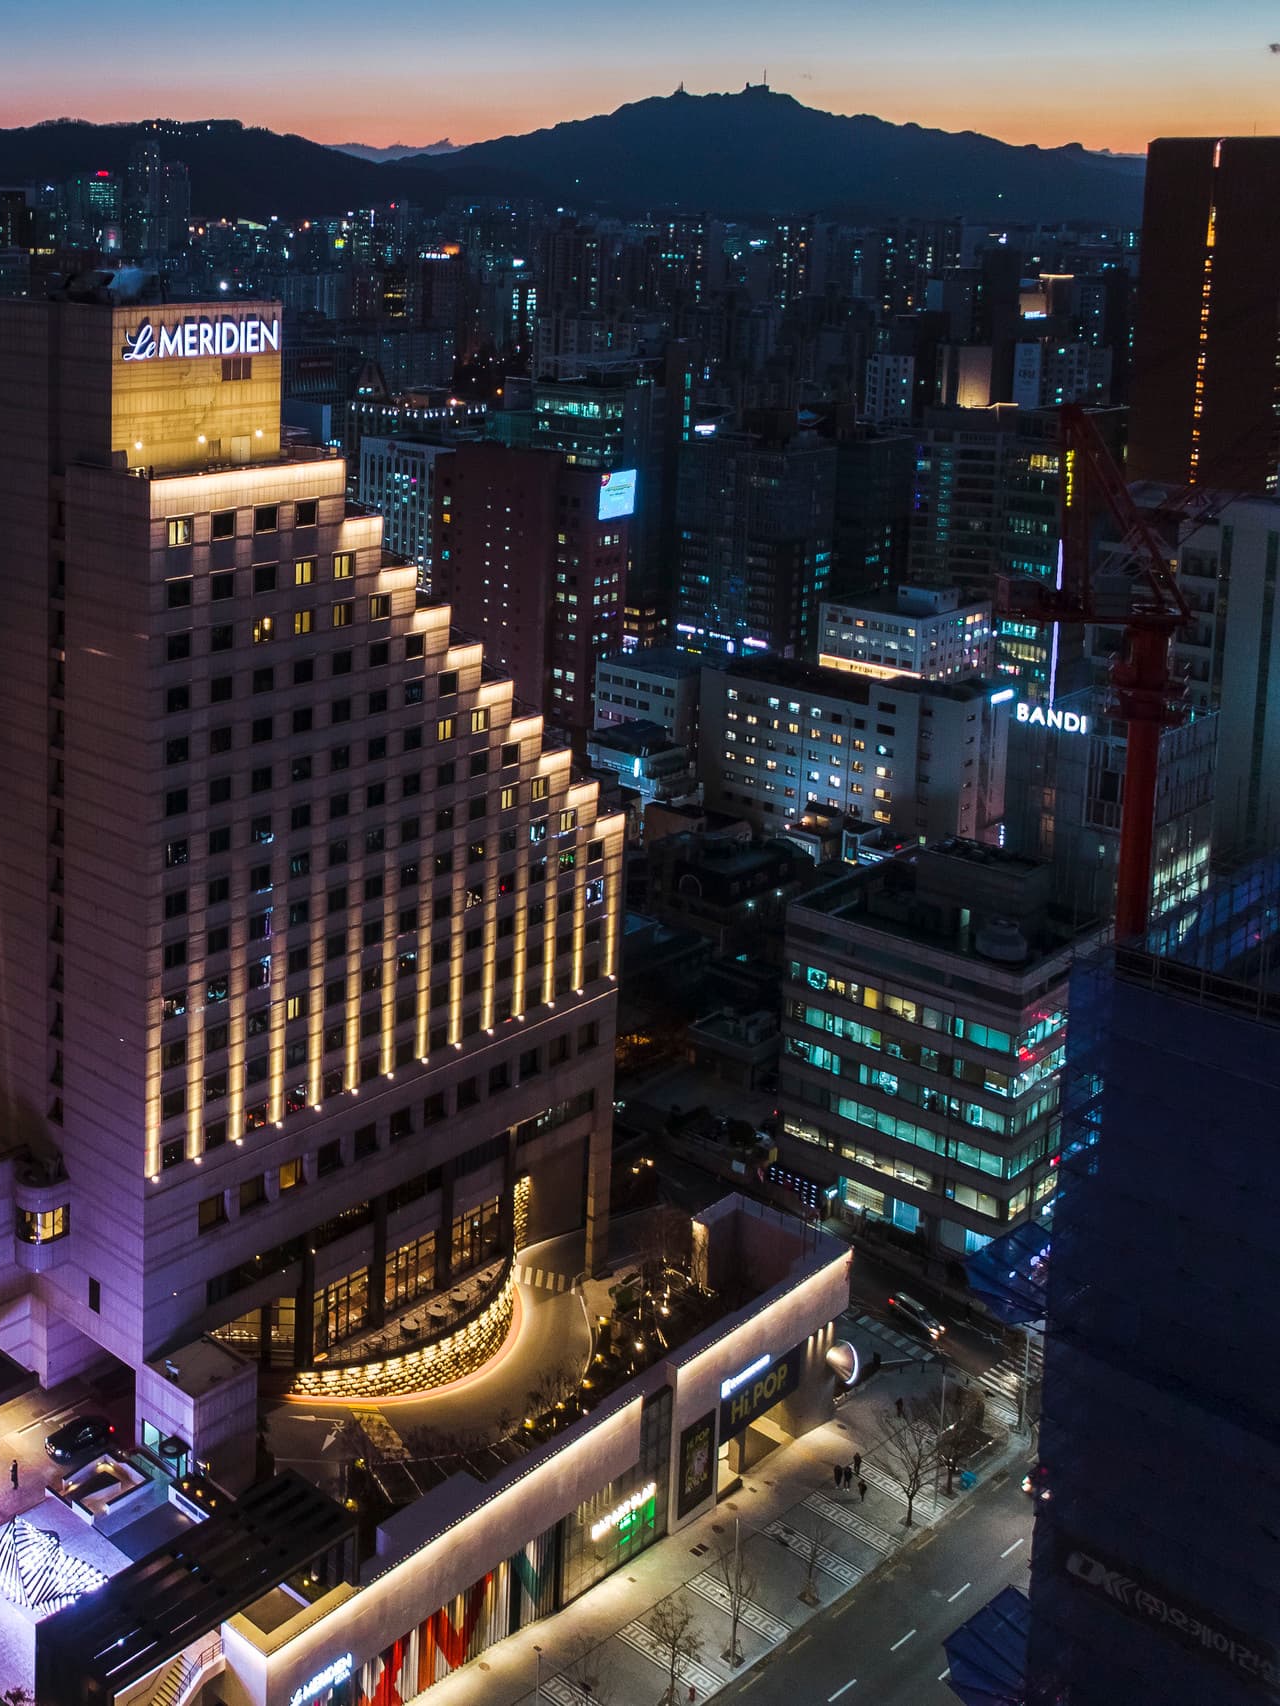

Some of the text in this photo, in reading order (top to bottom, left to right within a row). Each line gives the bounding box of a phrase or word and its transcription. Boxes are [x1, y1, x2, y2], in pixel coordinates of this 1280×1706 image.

[123, 320, 278, 361] Le MERIDIEN
[1016, 702, 1087, 734] BANDI
[753, 1363, 788, 1408] POP
